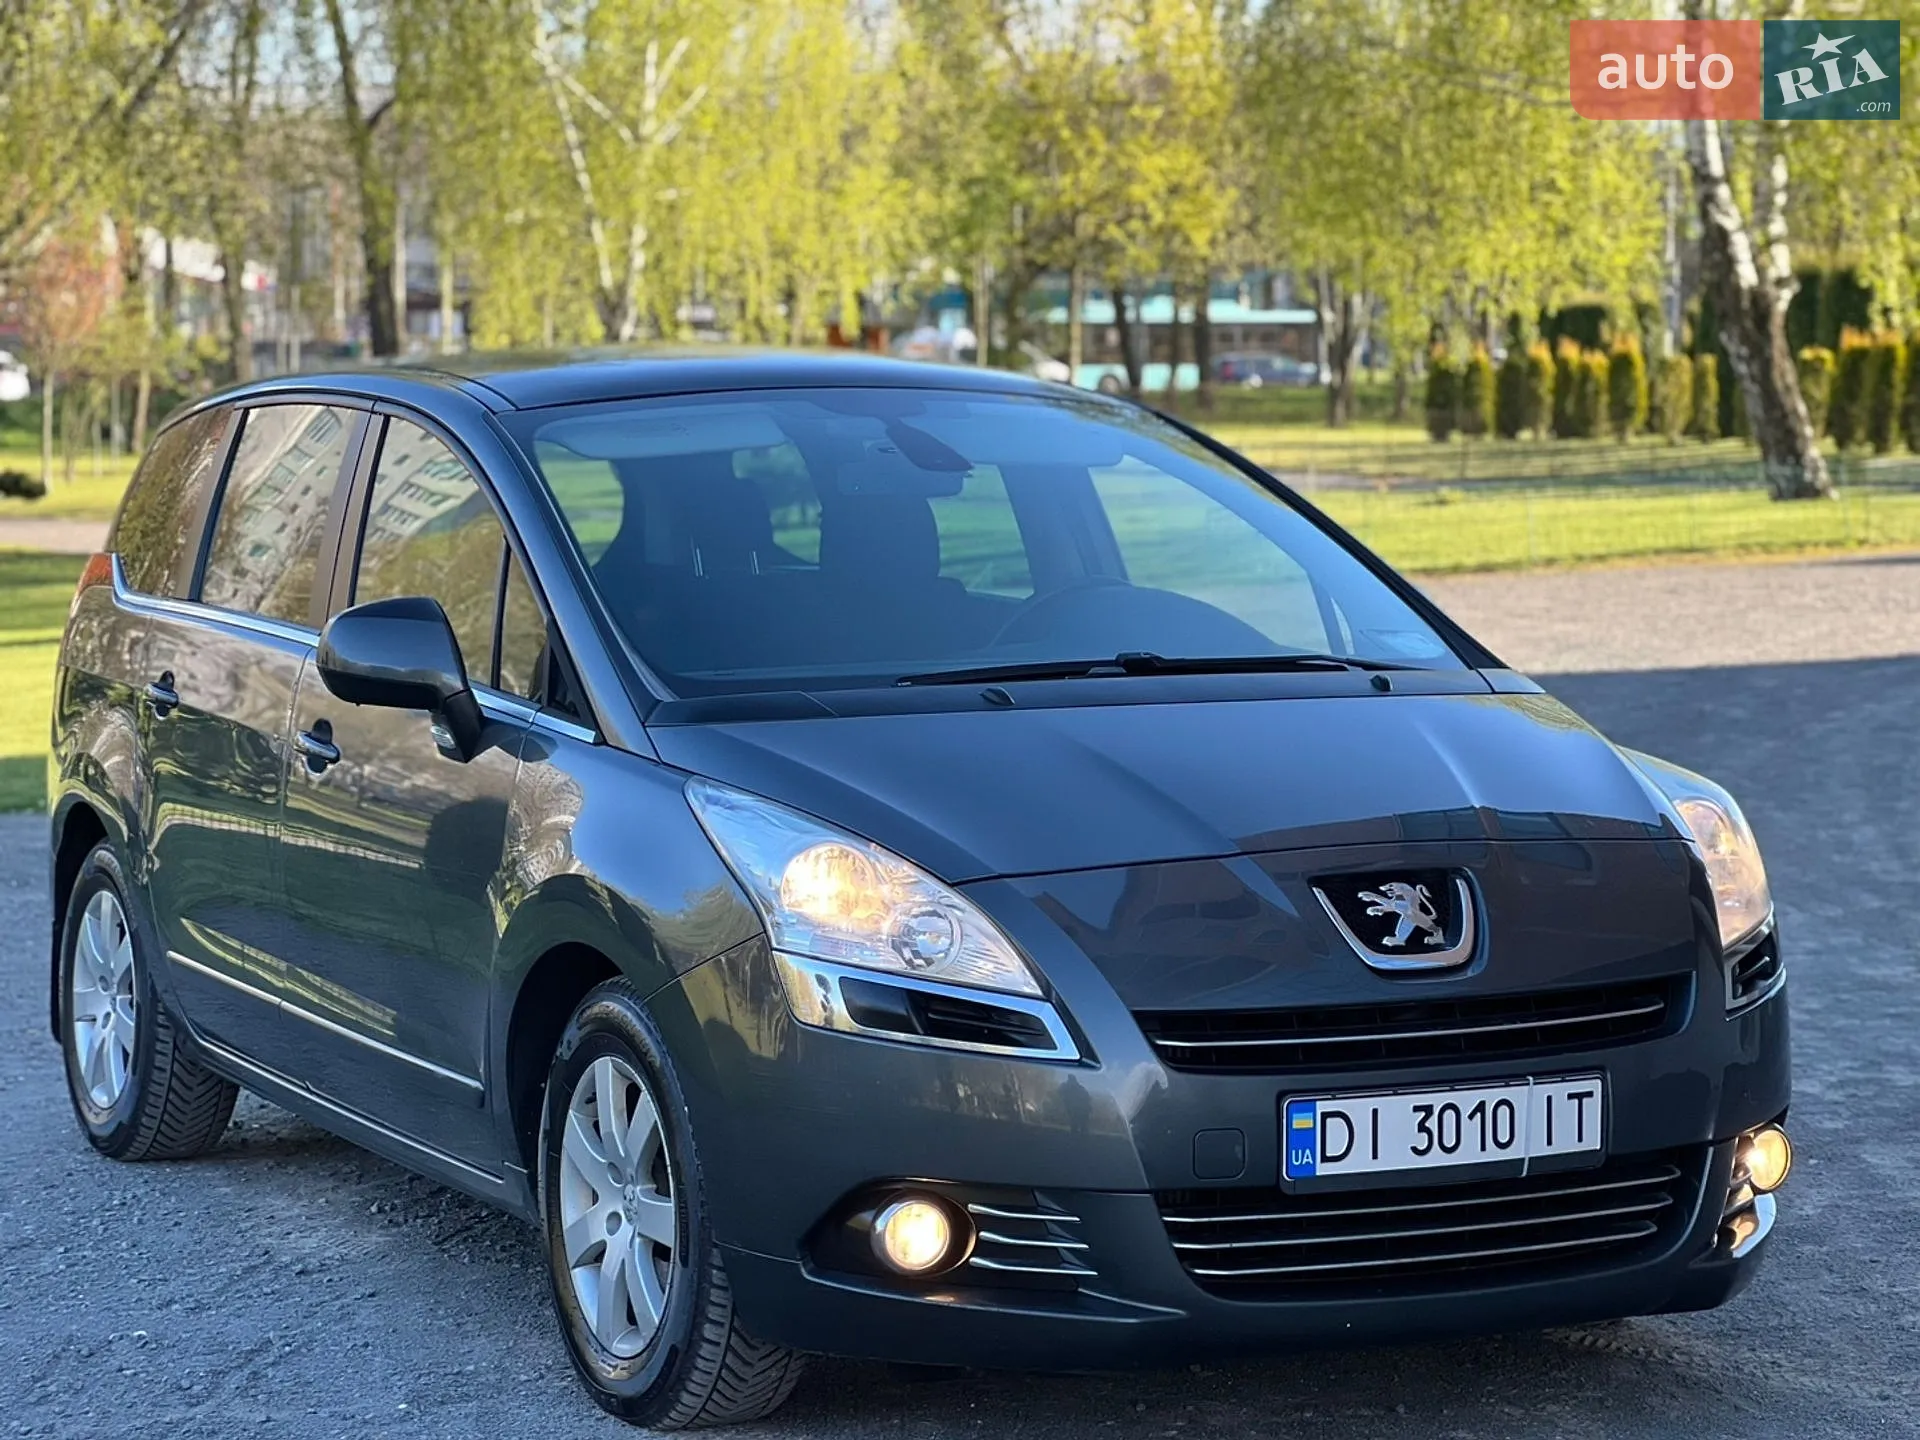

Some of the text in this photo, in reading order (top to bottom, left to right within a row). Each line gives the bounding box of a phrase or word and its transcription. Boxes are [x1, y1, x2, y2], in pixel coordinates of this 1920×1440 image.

[1320, 1090, 1594, 1164] DI 3010 IT
[1292, 1149, 1313, 1166] UA
